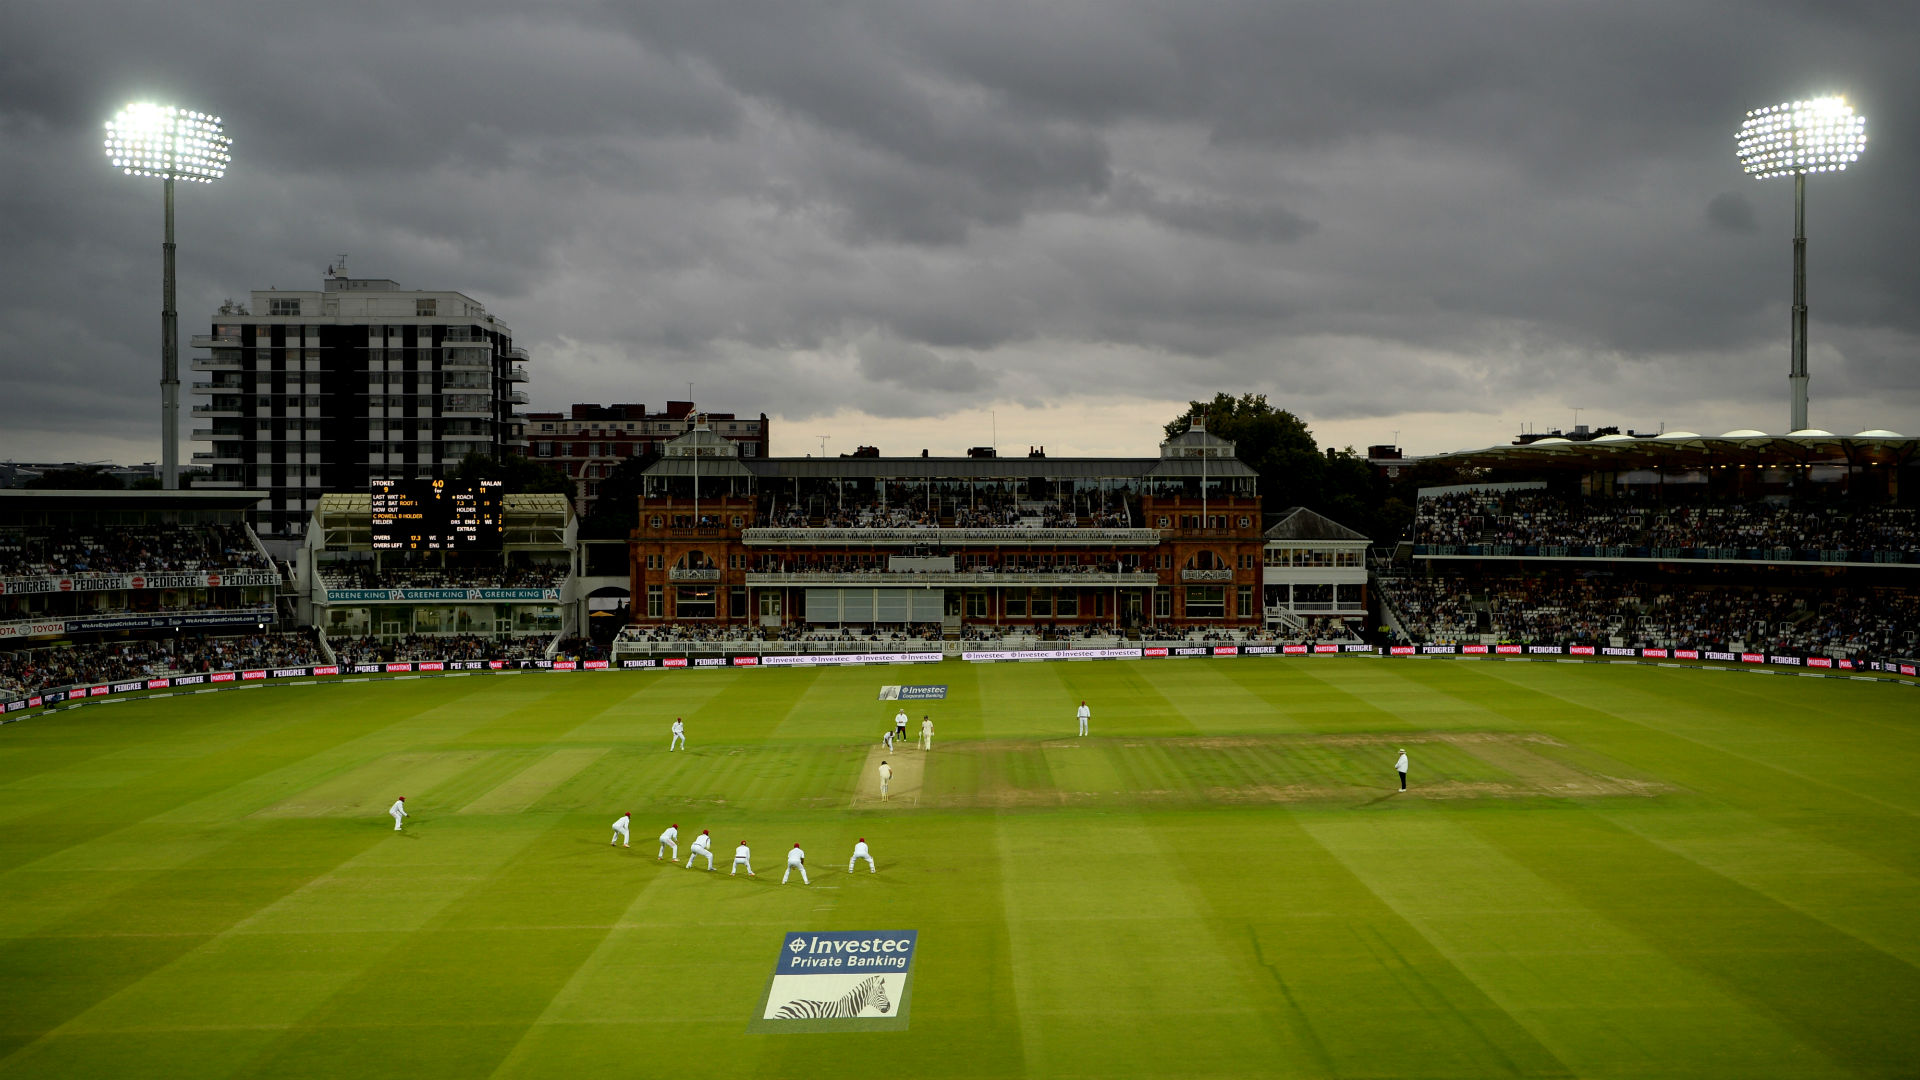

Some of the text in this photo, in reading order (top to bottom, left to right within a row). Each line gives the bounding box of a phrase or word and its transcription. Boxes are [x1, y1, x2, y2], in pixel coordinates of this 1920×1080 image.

[432, 480, 444, 488] 40
[74, 579, 120, 590] PEDIGREE
[146, 576, 196, 587] PEDIGREE
[223, 575, 274, 585] PEDIGREE
[6, 581, 49, 593] PEDIGREE
[388, 590, 405, 600] IPA
[466, 590, 482, 599] IPA
[542, 589, 558, 599] IPA
[32, 624, 63, 633] TOYOTA
[1705, 652, 1735, 660] PEDIGREE
[1771, 656, 1800, 665] PEDIGREE
[274, 669, 306, 677] PEDIGREE
[176, 676, 203, 685] PEDIGREE
[114, 682, 141, 692] PEDIGREE
[809, 937, 910, 954] Investec
[791, 956, 906, 968] Private Banking
